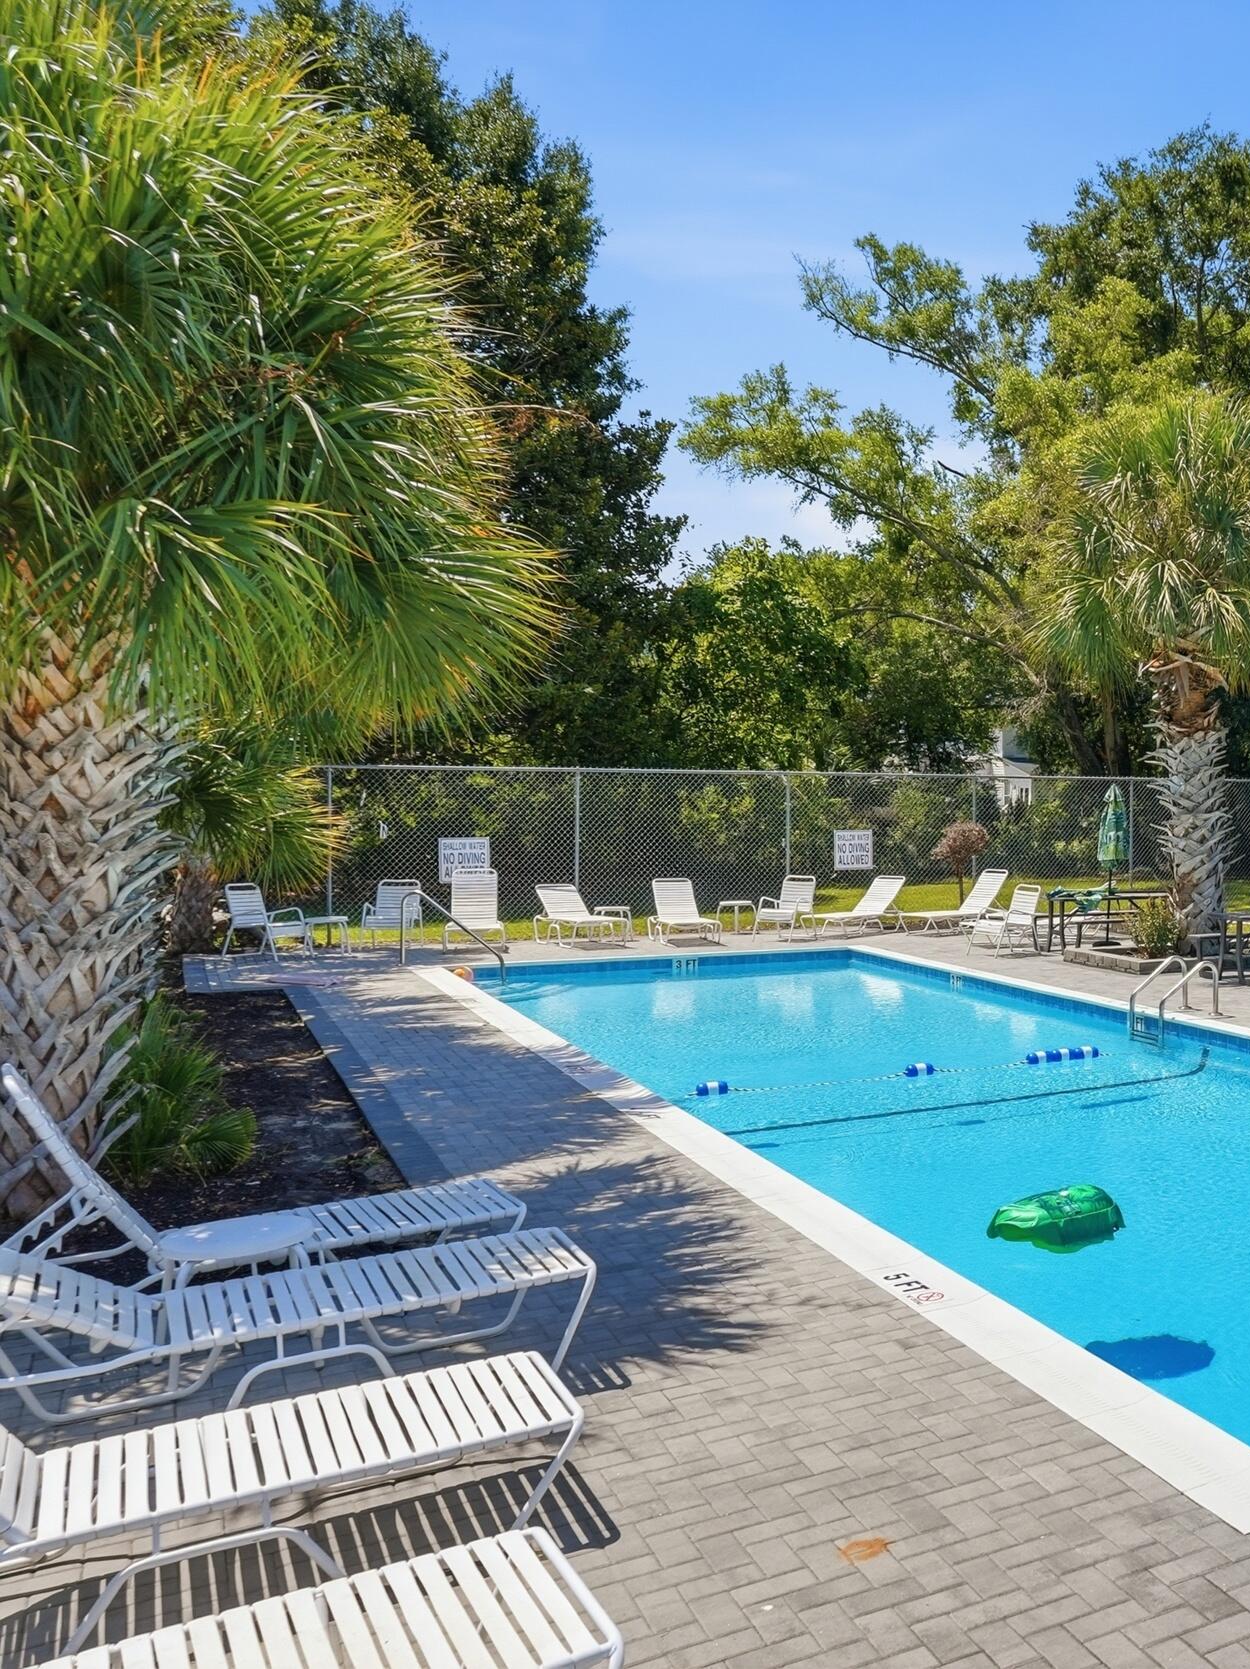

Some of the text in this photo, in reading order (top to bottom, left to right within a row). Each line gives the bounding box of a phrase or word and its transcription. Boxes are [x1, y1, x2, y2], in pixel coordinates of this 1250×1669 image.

[442, 841, 486, 851] SHALLOW WATER
[837, 843, 870, 854] NO DIVING
[443, 852, 486, 865] NO DIVING
[838, 854, 870, 865] ALLOWED
[675, 959, 682, 969] 3
[883, 1272, 930, 1293] 5 FT
